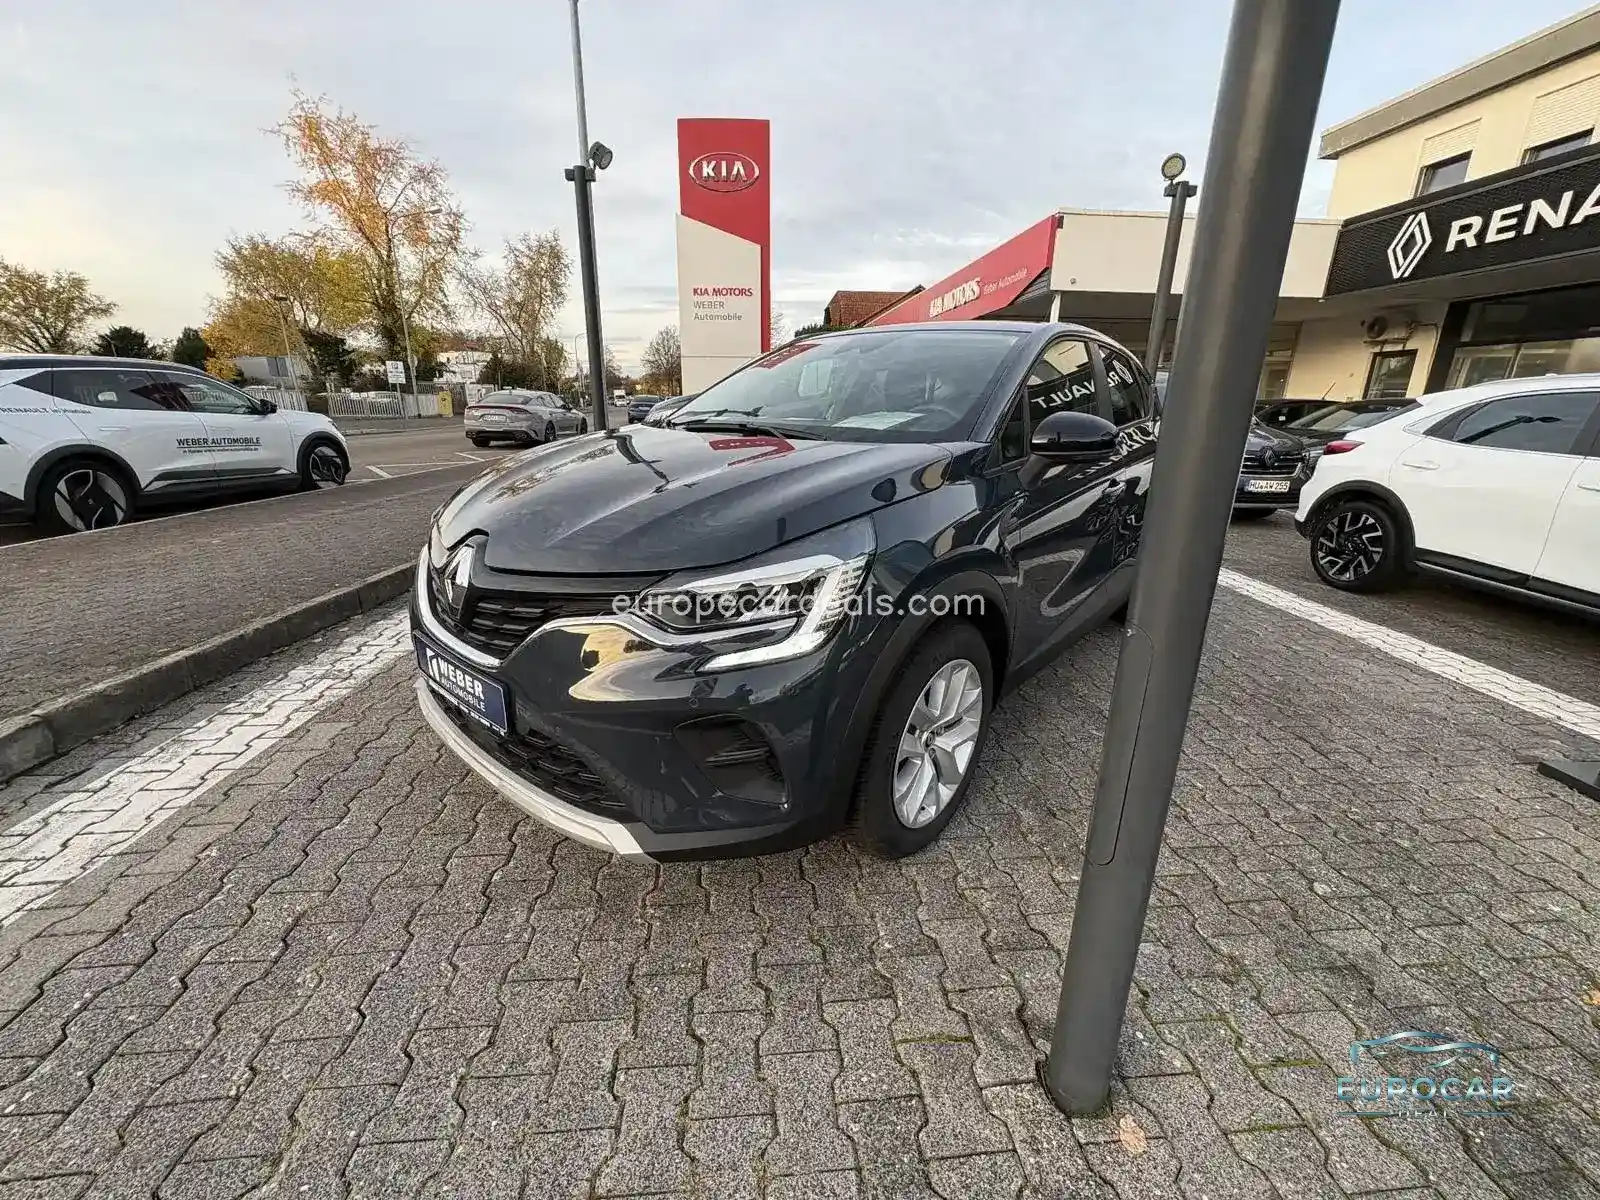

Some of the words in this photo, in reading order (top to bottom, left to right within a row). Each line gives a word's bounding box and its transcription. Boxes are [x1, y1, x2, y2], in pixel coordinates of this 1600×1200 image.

[702, 160, 748, 181] KIA
[692, 287, 710, 297] KIA
[711, 287, 753, 298] MOTORS
[693, 300, 725, 310] WEBER
[693, 312, 742, 321] Automobile
[176, 437, 209, 447] WEBER
[210, 436, 261, 446] AUTOMOBILE
[438, 656, 485, 700] WEBER
